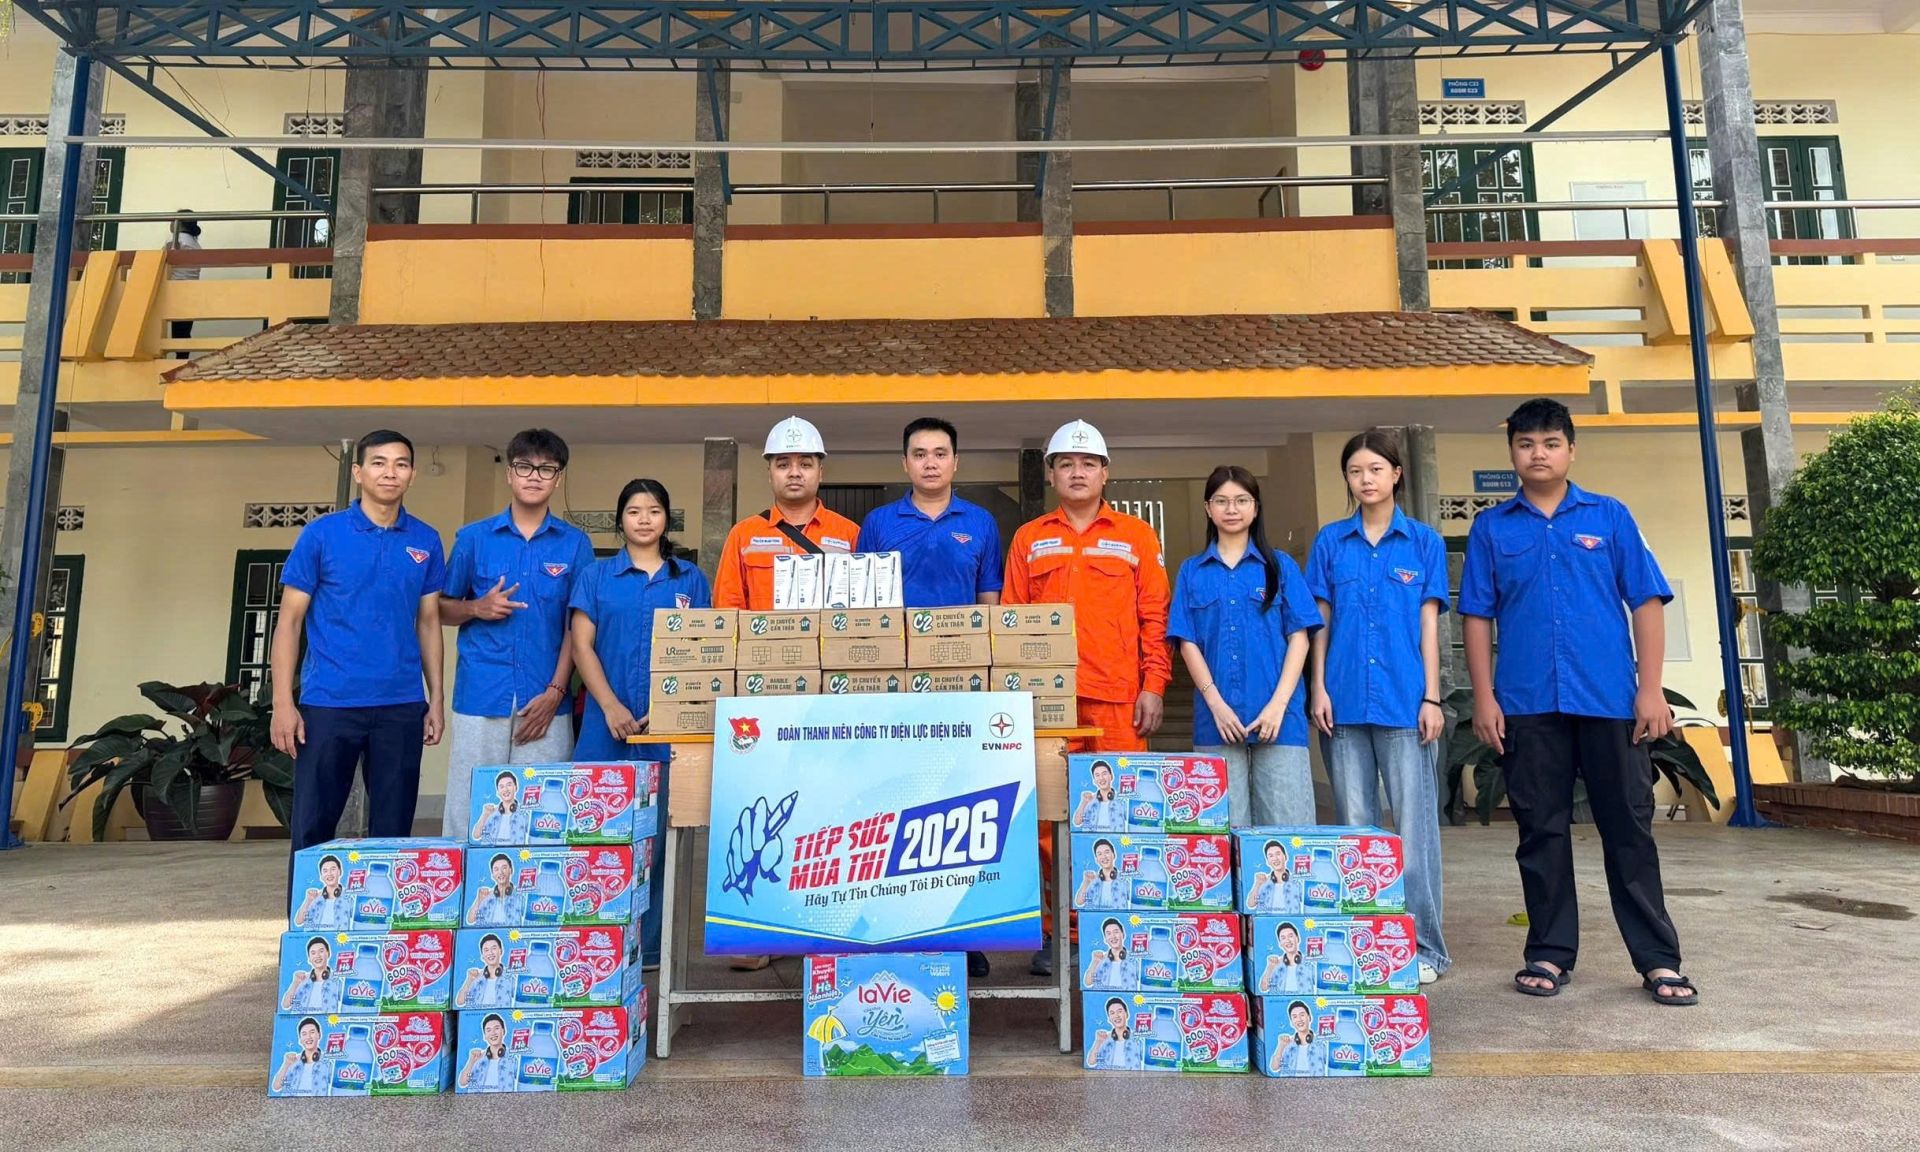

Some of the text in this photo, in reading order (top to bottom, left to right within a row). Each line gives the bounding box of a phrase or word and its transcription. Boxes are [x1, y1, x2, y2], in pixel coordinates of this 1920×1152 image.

[666, 617, 682, 631] C2
[750, 618, 767, 634] C2
[832, 615, 848, 630] C2
[913, 614, 933, 632] C2
[1002, 613, 1017, 627] C2
[662, 679, 678, 694] C2
[746, 676, 764, 692] C2
[830, 676, 849, 694] C2
[912, 676, 932, 692] C2
[1005, 675, 1020, 690] C2
[778, 721, 972, 742] ĐOÀN THANH NIÊN CÔNG TY ĐIỆN LỰC ĐIỆN BIÊN
[1168, 791, 1185, 805] 600
[571, 801, 590, 815] 600
[793, 812, 896, 862] TIẾP SỨC
[898, 799, 999, 871] 2026
[788, 848, 887, 891] MÙA THI
[1171, 870, 1188, 883] 600
[1344, 872, 1362, 885] 600
[398, 885, 417, 899] 600
[568, 884, 588, 898] 600
[804, 870, 1001, 908] Hãy Tự Tin Chúng Tôi Đi Cùng Bạn
[1181, 950, 1198, 964] 600
[1357, 953, 1374, 967] 600
[387, 968, 406, 982] 600
[559, 964, 578, 978] 600
[816, 981, 831, 993] Hè
[1186, 1030, 1203, 1044] 600
[1369, 1032, 1386, 1046] 600
[377, 1052, 396, 1064] 600
[562, 1045, 582, 1060] 600
